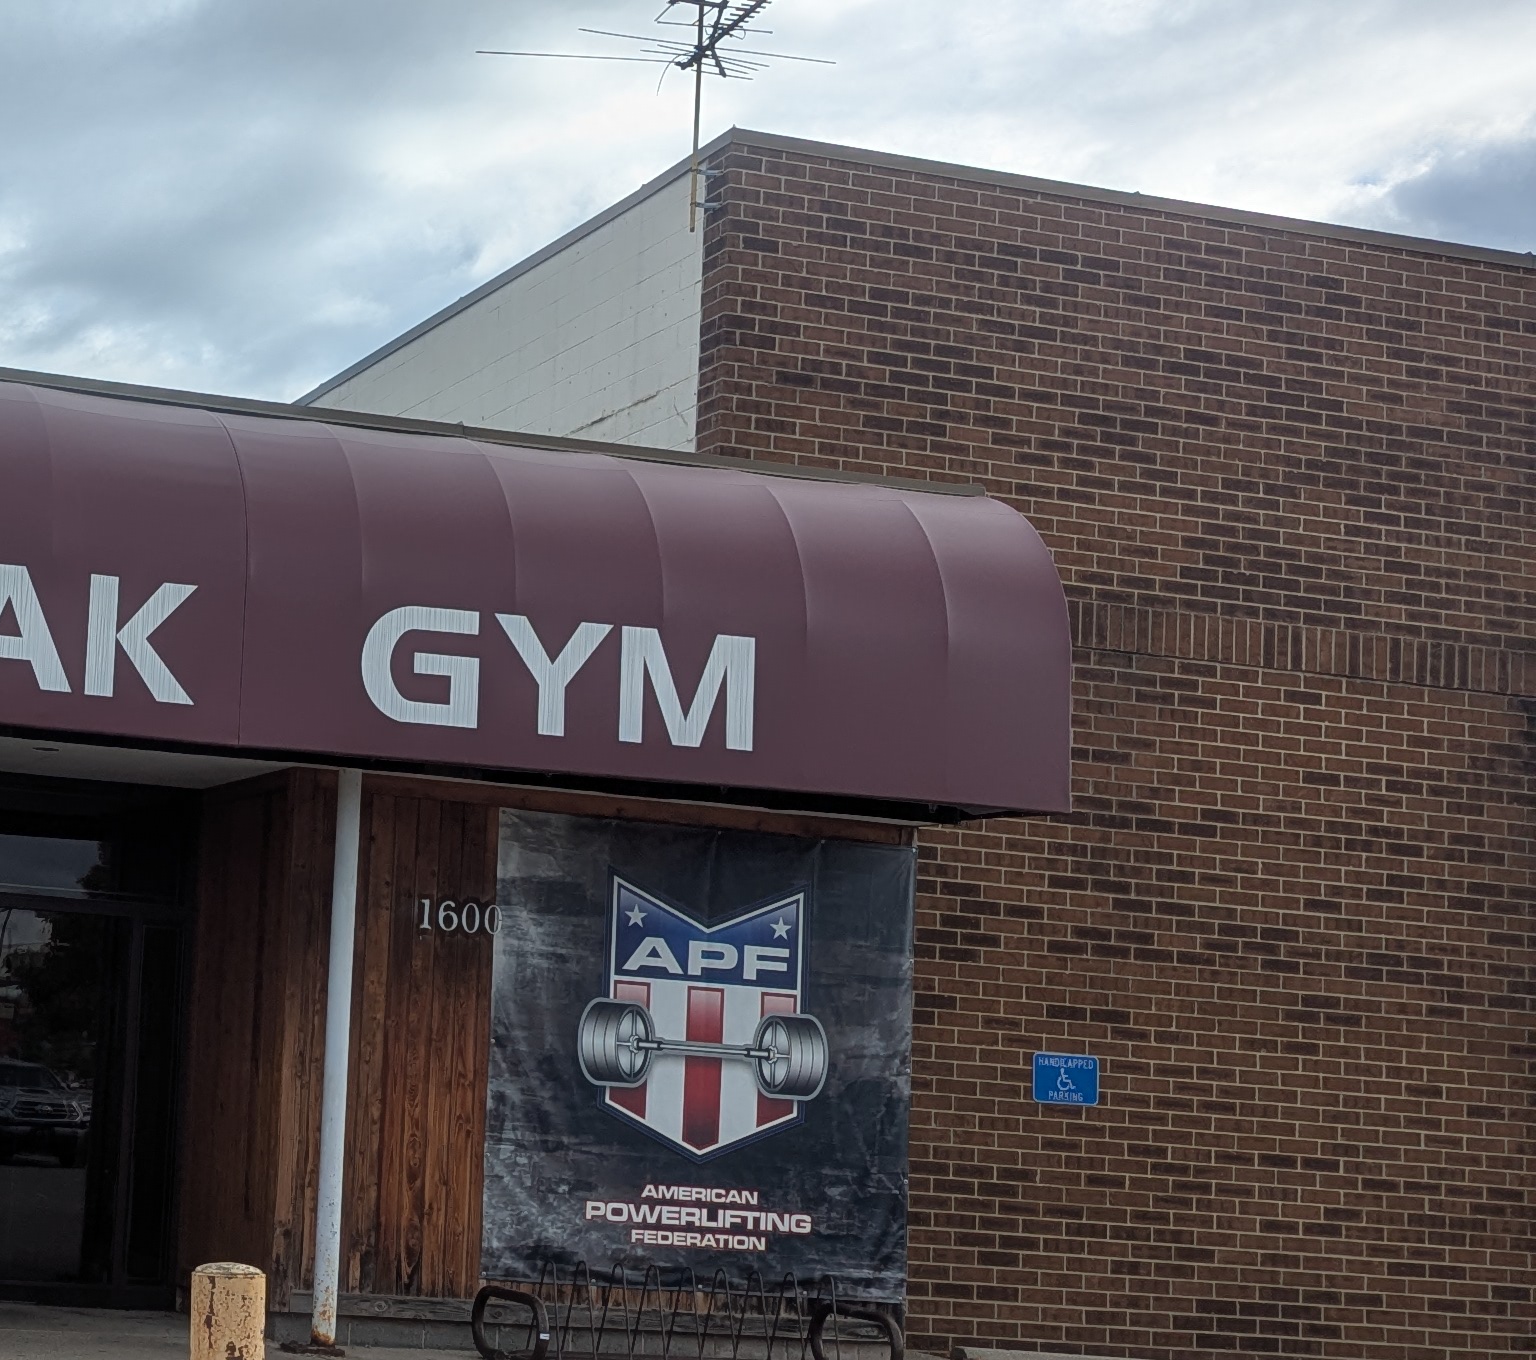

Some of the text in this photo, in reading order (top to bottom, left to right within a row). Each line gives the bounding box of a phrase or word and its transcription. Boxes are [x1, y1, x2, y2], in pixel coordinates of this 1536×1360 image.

[361, 605, 757, 752] GYM
[419, 899, 503, 935] 1600
[622, 935, 790, 981] APF
[1038, 1056, 1093, 1069] HANDICAPPED
[1048, 1091, 1083, 1102] PARKING
[640, 1184, 759, 1206] AMERICAN
[584, 1200, 813, 1235] POWERLIFTING
[630, 1229, 767, 1252] FEDERATION
